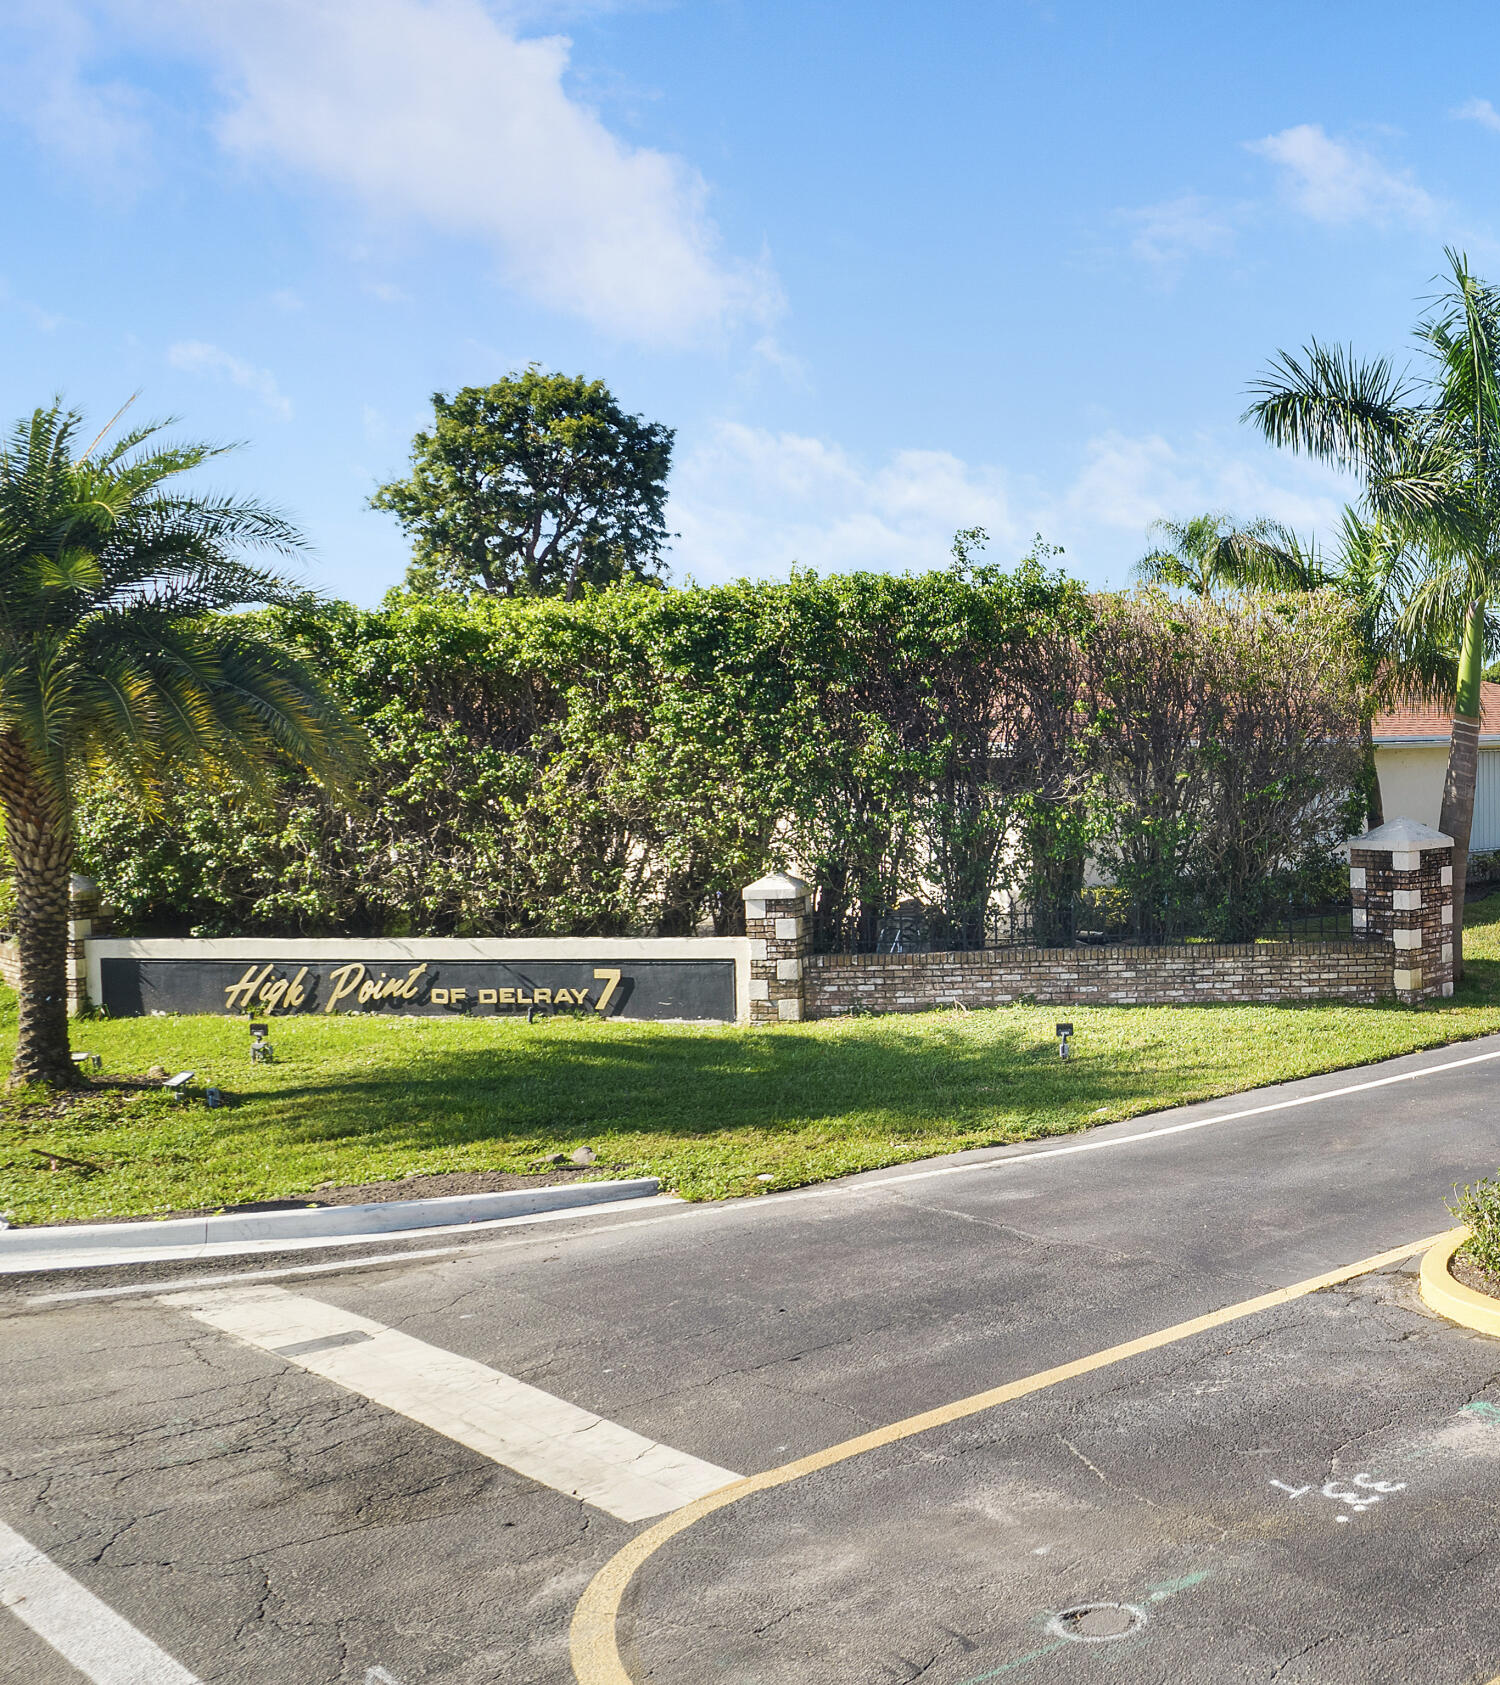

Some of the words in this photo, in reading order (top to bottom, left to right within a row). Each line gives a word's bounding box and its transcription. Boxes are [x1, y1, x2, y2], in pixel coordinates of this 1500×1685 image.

[224, 963, 309, 1015] High
[324, 962, 428, 1013] Point
[431, 988, 466, 1004] OF
[478, 987, 589, 1005] DELRAY
[593, 968, 621, 1010] 7
